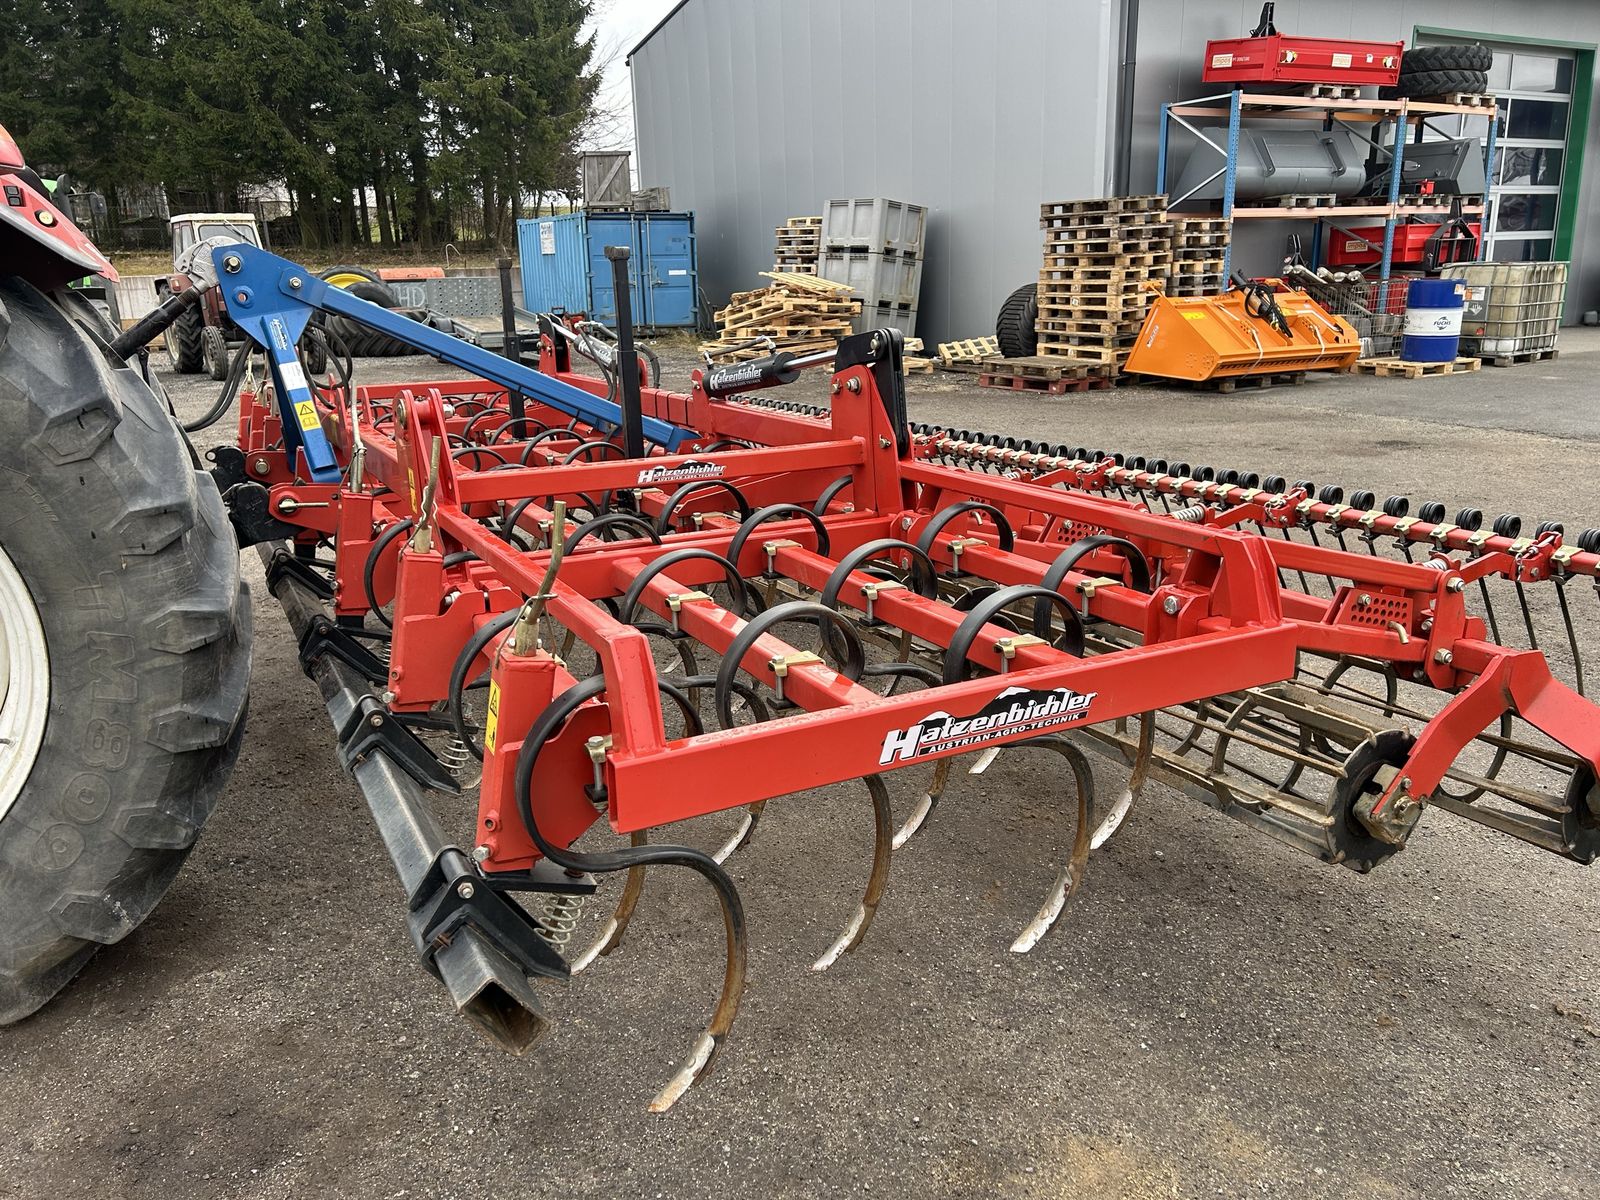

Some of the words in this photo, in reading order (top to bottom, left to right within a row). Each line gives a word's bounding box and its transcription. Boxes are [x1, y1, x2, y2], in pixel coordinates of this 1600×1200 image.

[710, 364, 763, 390] Hatzenbichler
[637, 464, 726, 484] Hatzenbichler
[879, 692, 1098, 765] Hatzenbichler
[928, 713, 1080, 753] AUSTRIAN-AGRO-TECHNIK
